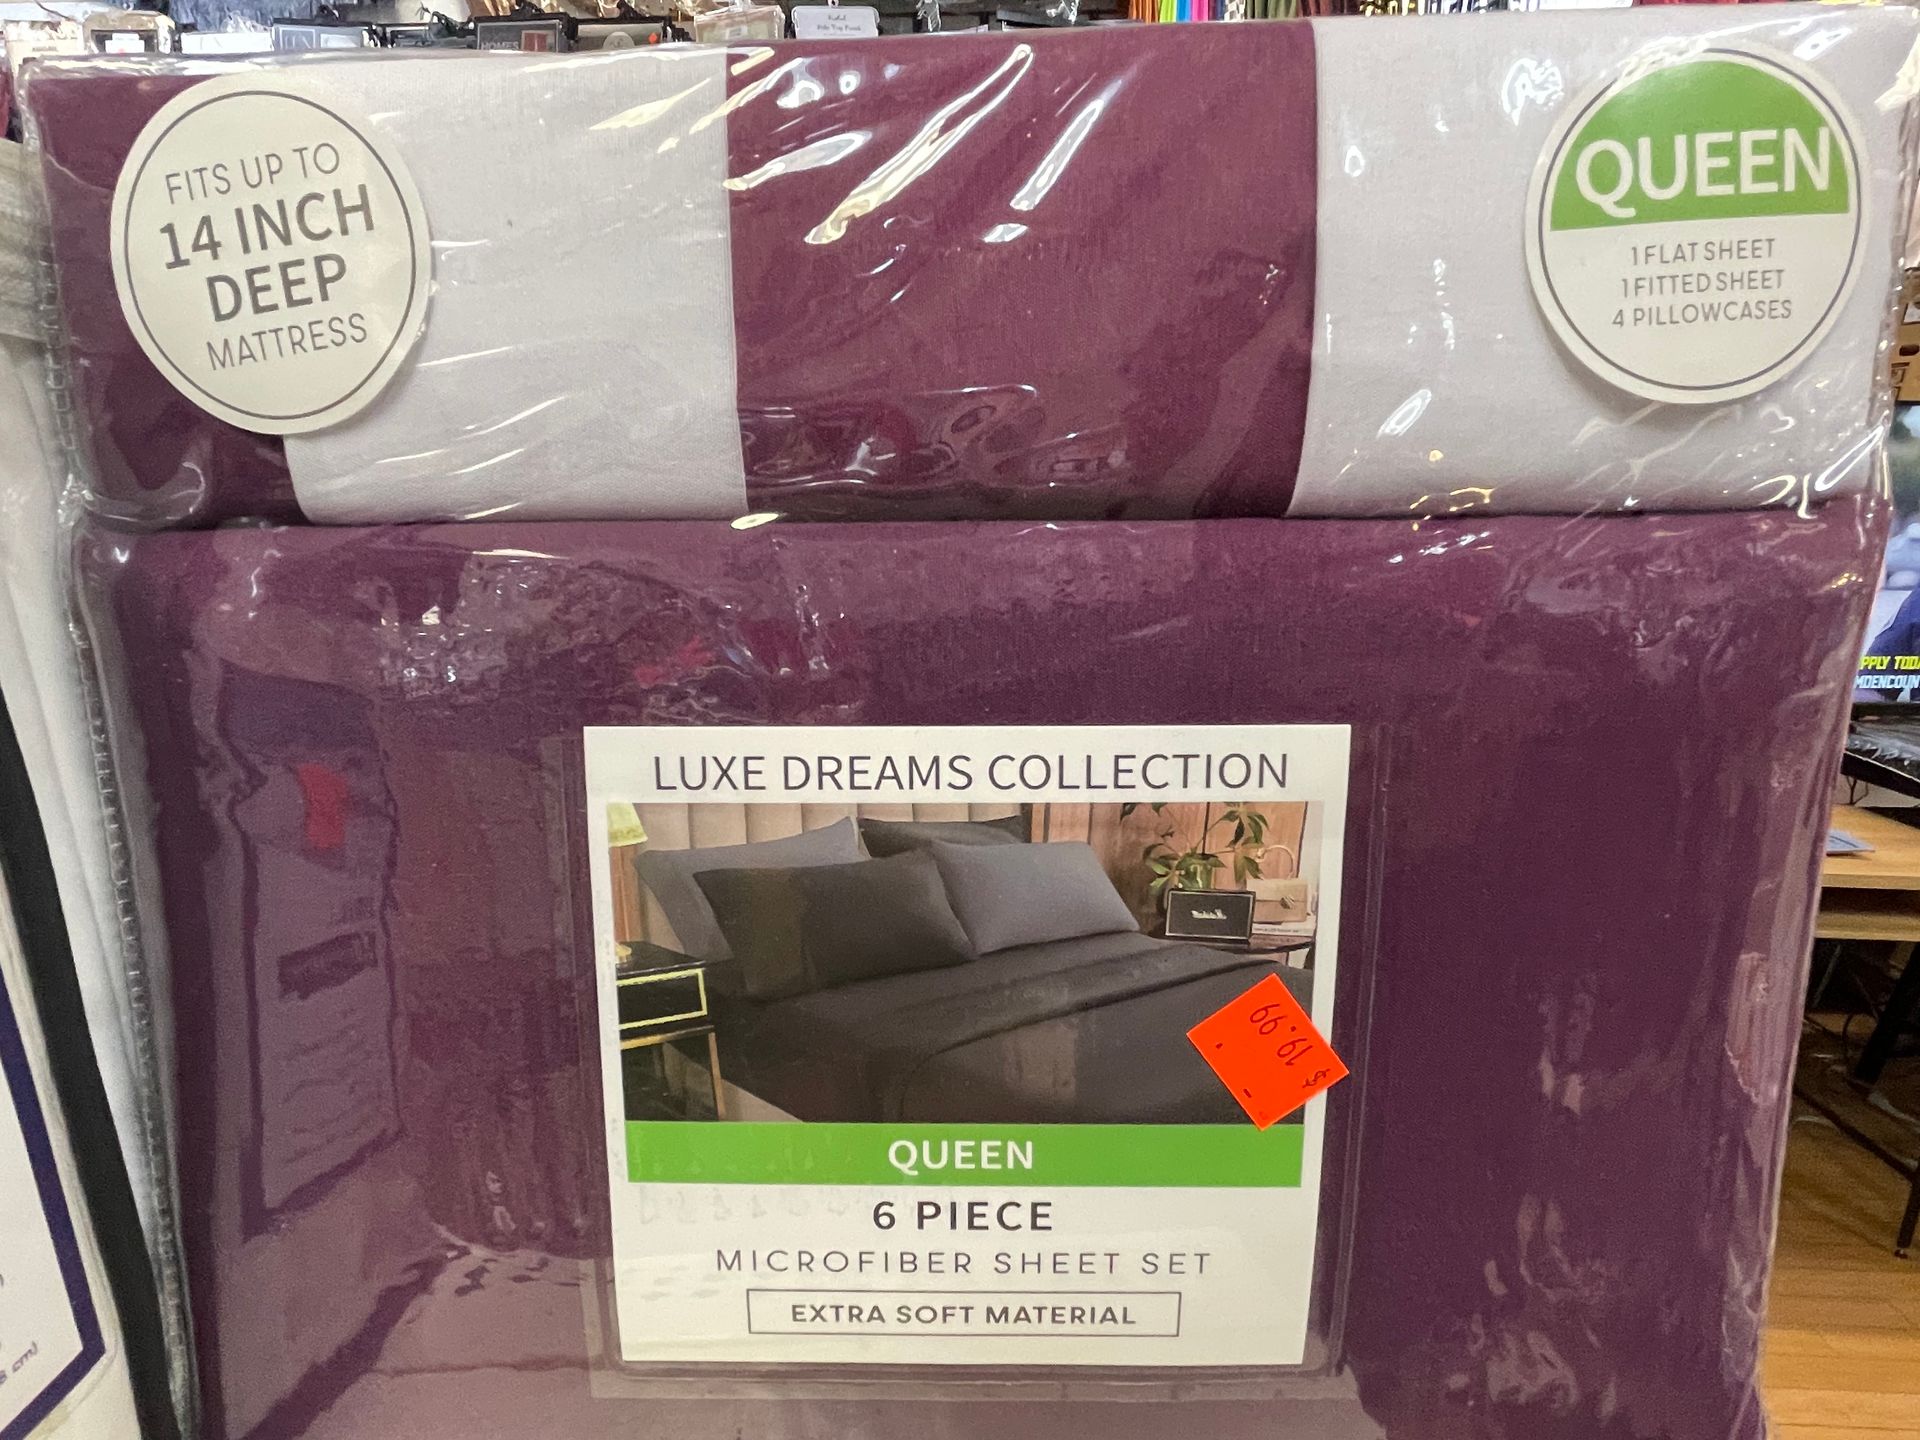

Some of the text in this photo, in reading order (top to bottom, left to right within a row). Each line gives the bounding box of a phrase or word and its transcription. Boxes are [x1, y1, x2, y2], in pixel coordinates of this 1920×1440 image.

[165, 143, 339, 205] FITS UP TO
[1576, 126, 1830, 218] QUEEN
[160, 184, 374, 269] 14 INCH
[1631, 238, 1775, 265] 1 FLAT SHEET
[206, 253, 346, 322] DEEP
[1622, 269, 1785, 298] 1 FITTED SHEET
[1612, 300, 1793, 328] 4 PILLOWCASES
[206, 313, 368, 370] MATTRESS
[1858, 655, 1891, 670] PPLY
[654, 752, 1288, 791] LUXE DREAMS COLLECTION
[888, 1140, 1034, 1176] QUEEN
[873, 1201, 1053, 1231] 6 PIECE
[716, 1249, 1212, 1275] MICROFIBER SHEET SET
[791, 1304, 1136, 1325] EXTRA SOFT MATERIAL
